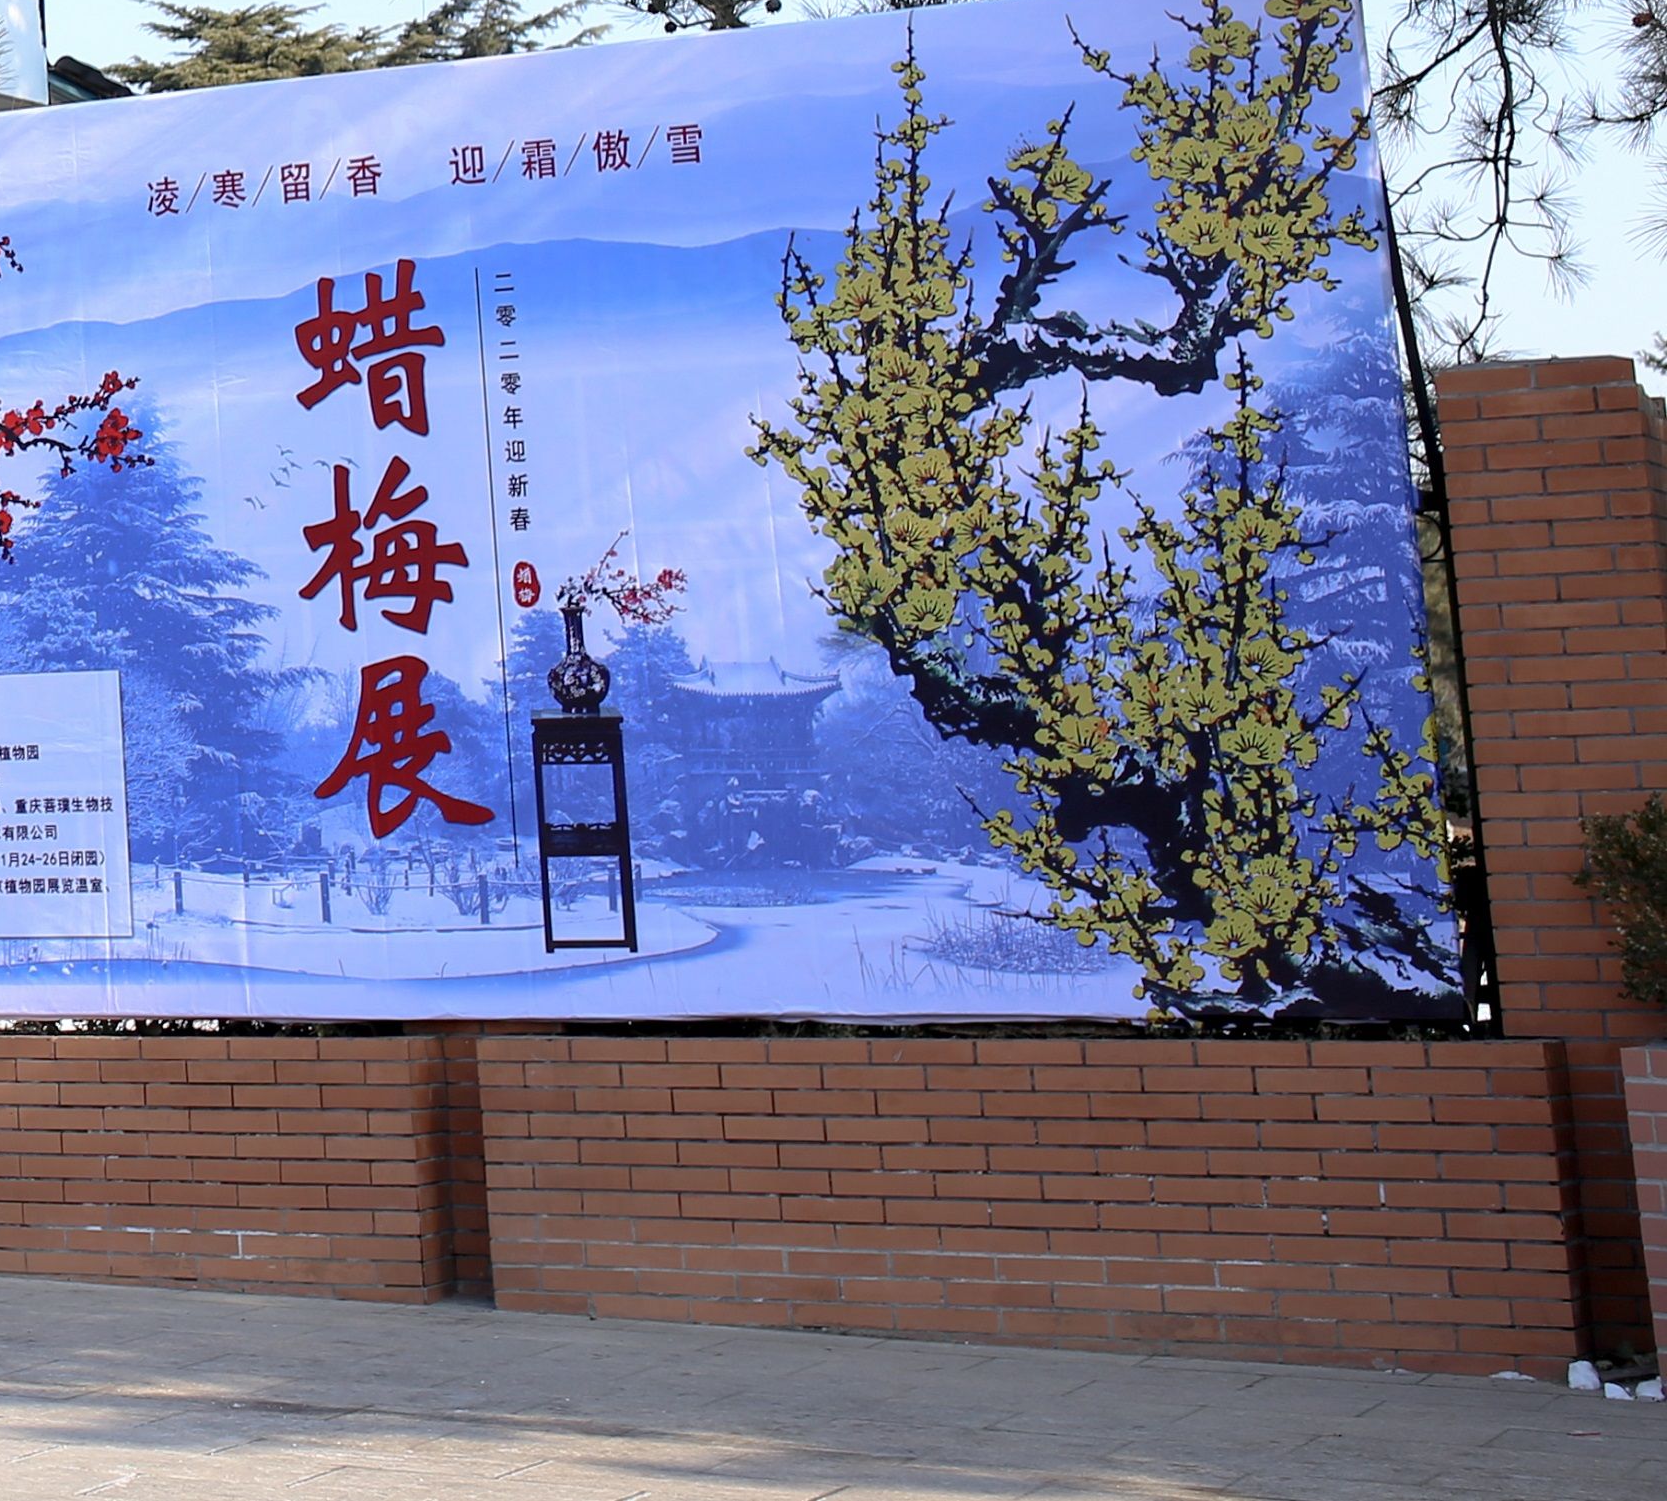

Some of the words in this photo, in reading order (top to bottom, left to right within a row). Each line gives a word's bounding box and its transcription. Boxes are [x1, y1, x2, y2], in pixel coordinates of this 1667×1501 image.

[294, 257, 496, 840] 蜡梅展
[494, 272, 532, 532] 二零二零年迎新春
